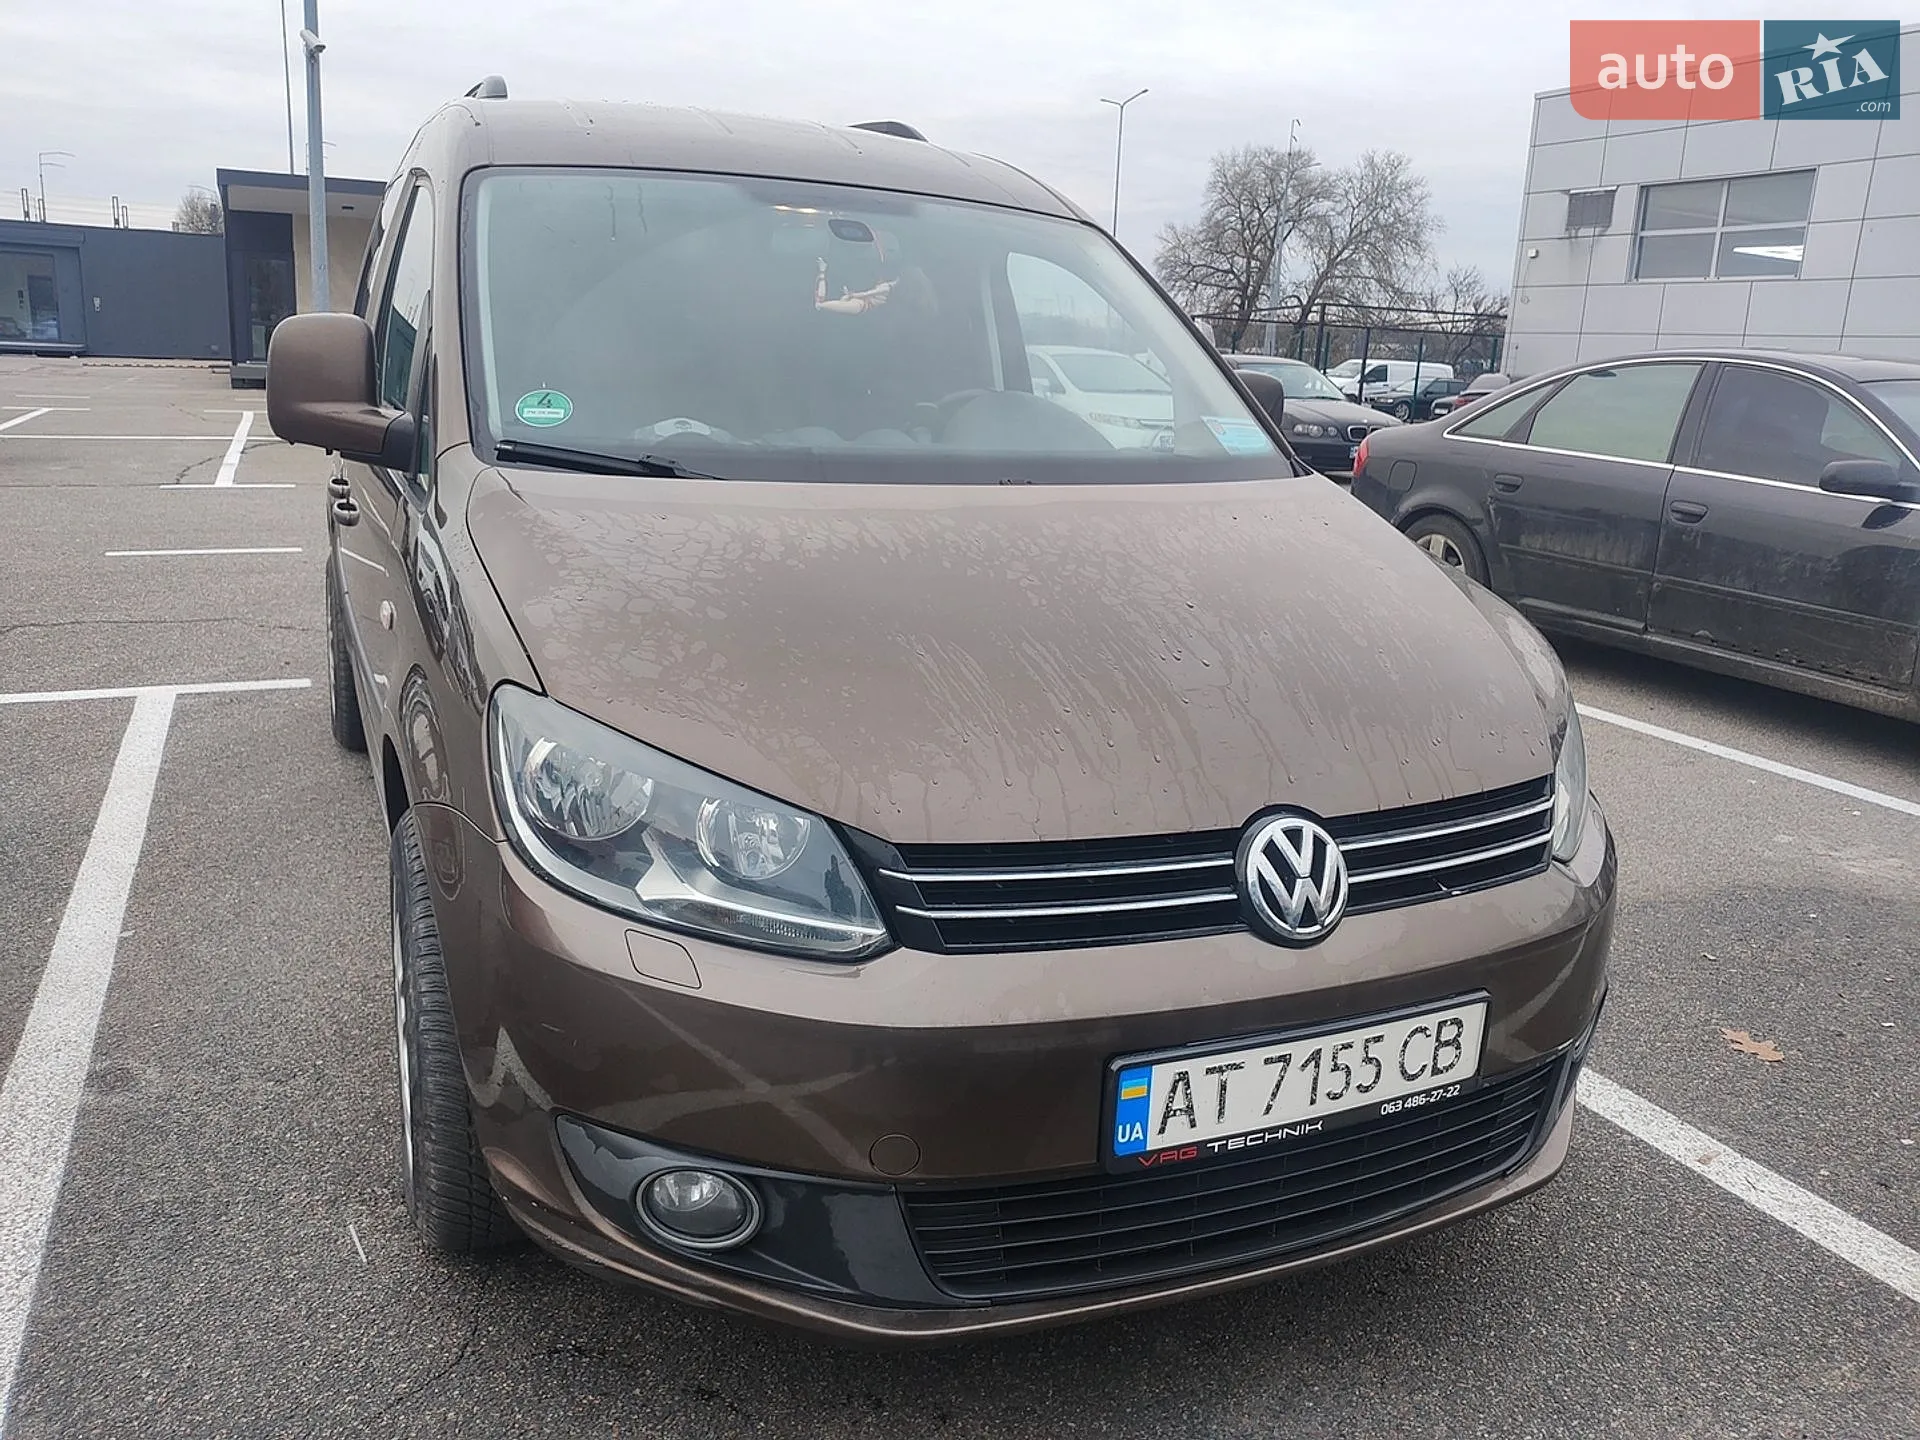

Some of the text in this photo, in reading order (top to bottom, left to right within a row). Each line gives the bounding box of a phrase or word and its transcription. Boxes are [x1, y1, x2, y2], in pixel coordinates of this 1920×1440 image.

[1158, 1017, 1464, 1136] AT 7155 CB
[1380, 1084, 1461, 1116] 063 486-27-22
[1117, 1122, 1144, 1143] UA
[1138, 1119, 1324, 1167] VAG TECHNIK
